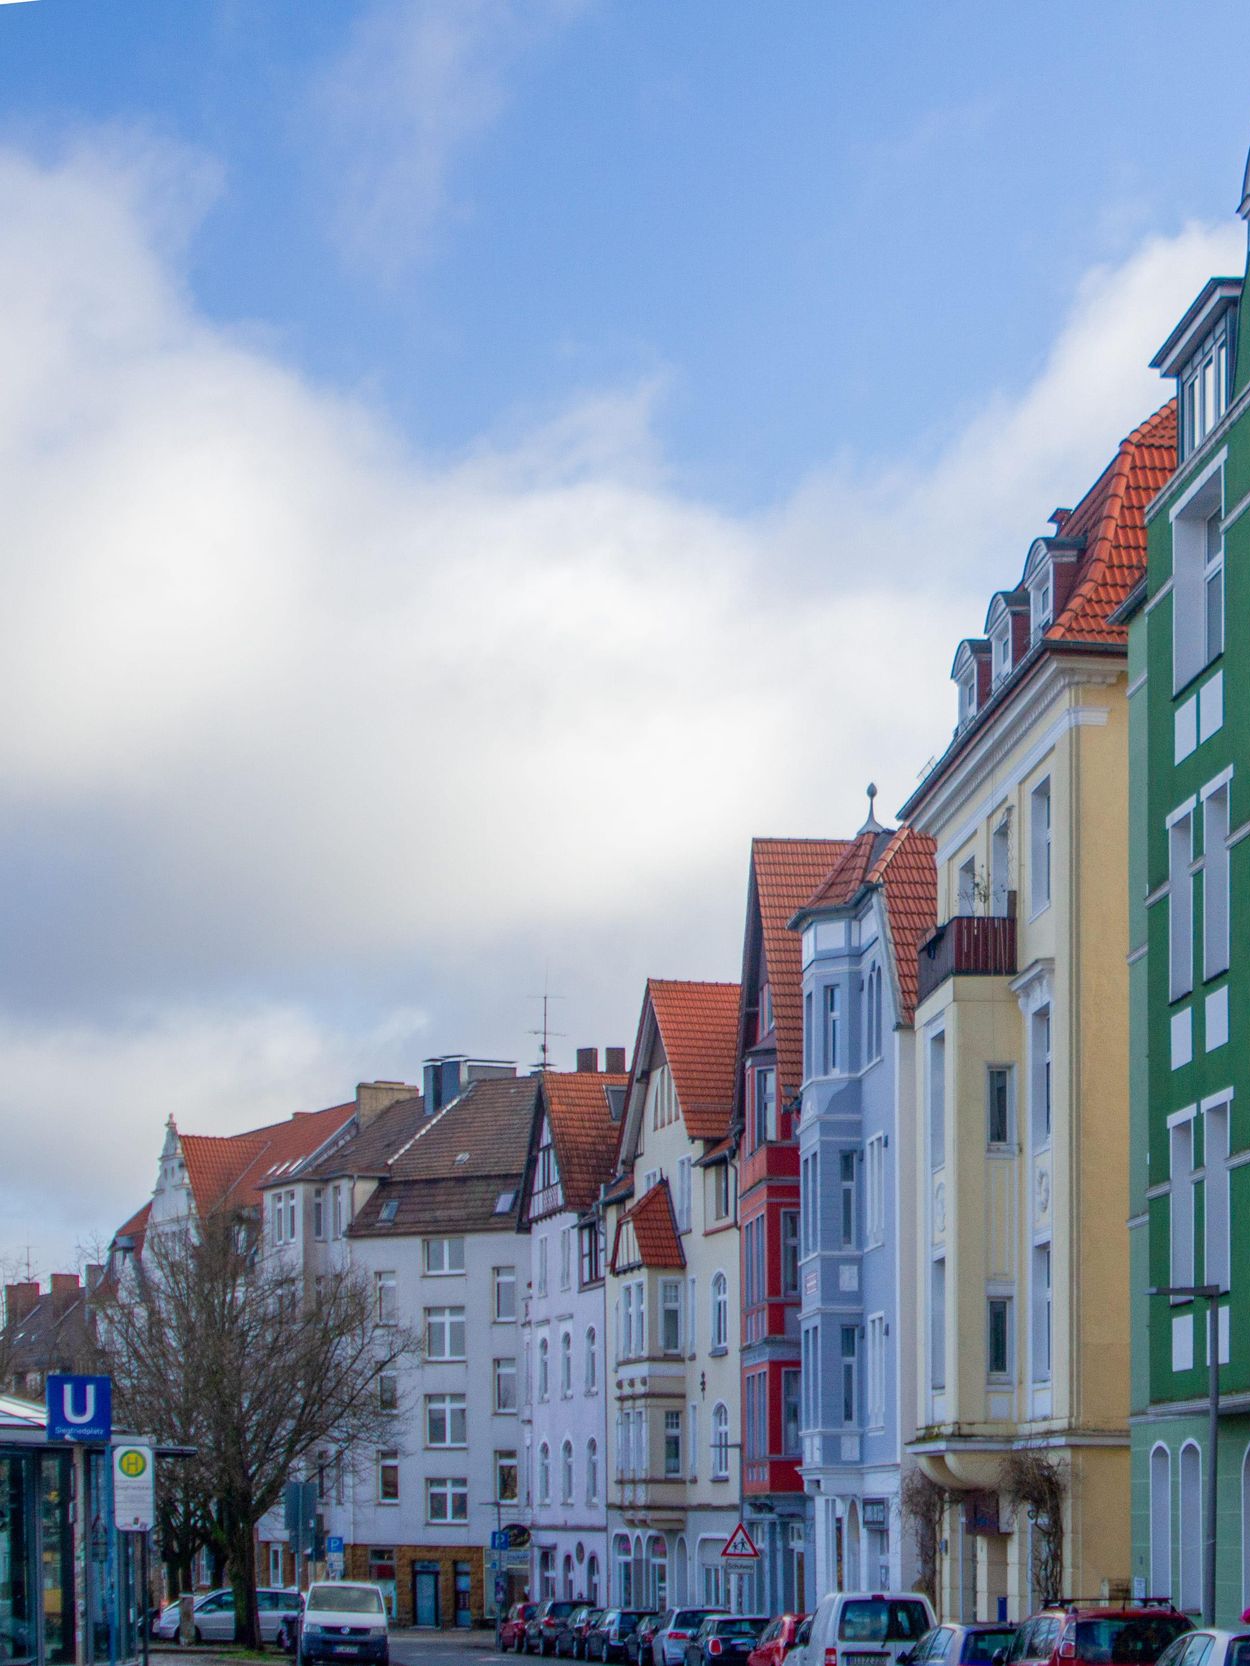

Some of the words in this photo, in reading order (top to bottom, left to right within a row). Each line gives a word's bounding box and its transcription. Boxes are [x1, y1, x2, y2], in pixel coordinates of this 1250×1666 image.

[63, 1384, 95, 1424] U
[55, 1427, 104, 1436] Siegfriedplatz
[127, 1455, 139, 1473] H
[331, 1538, 340, 1550] P
